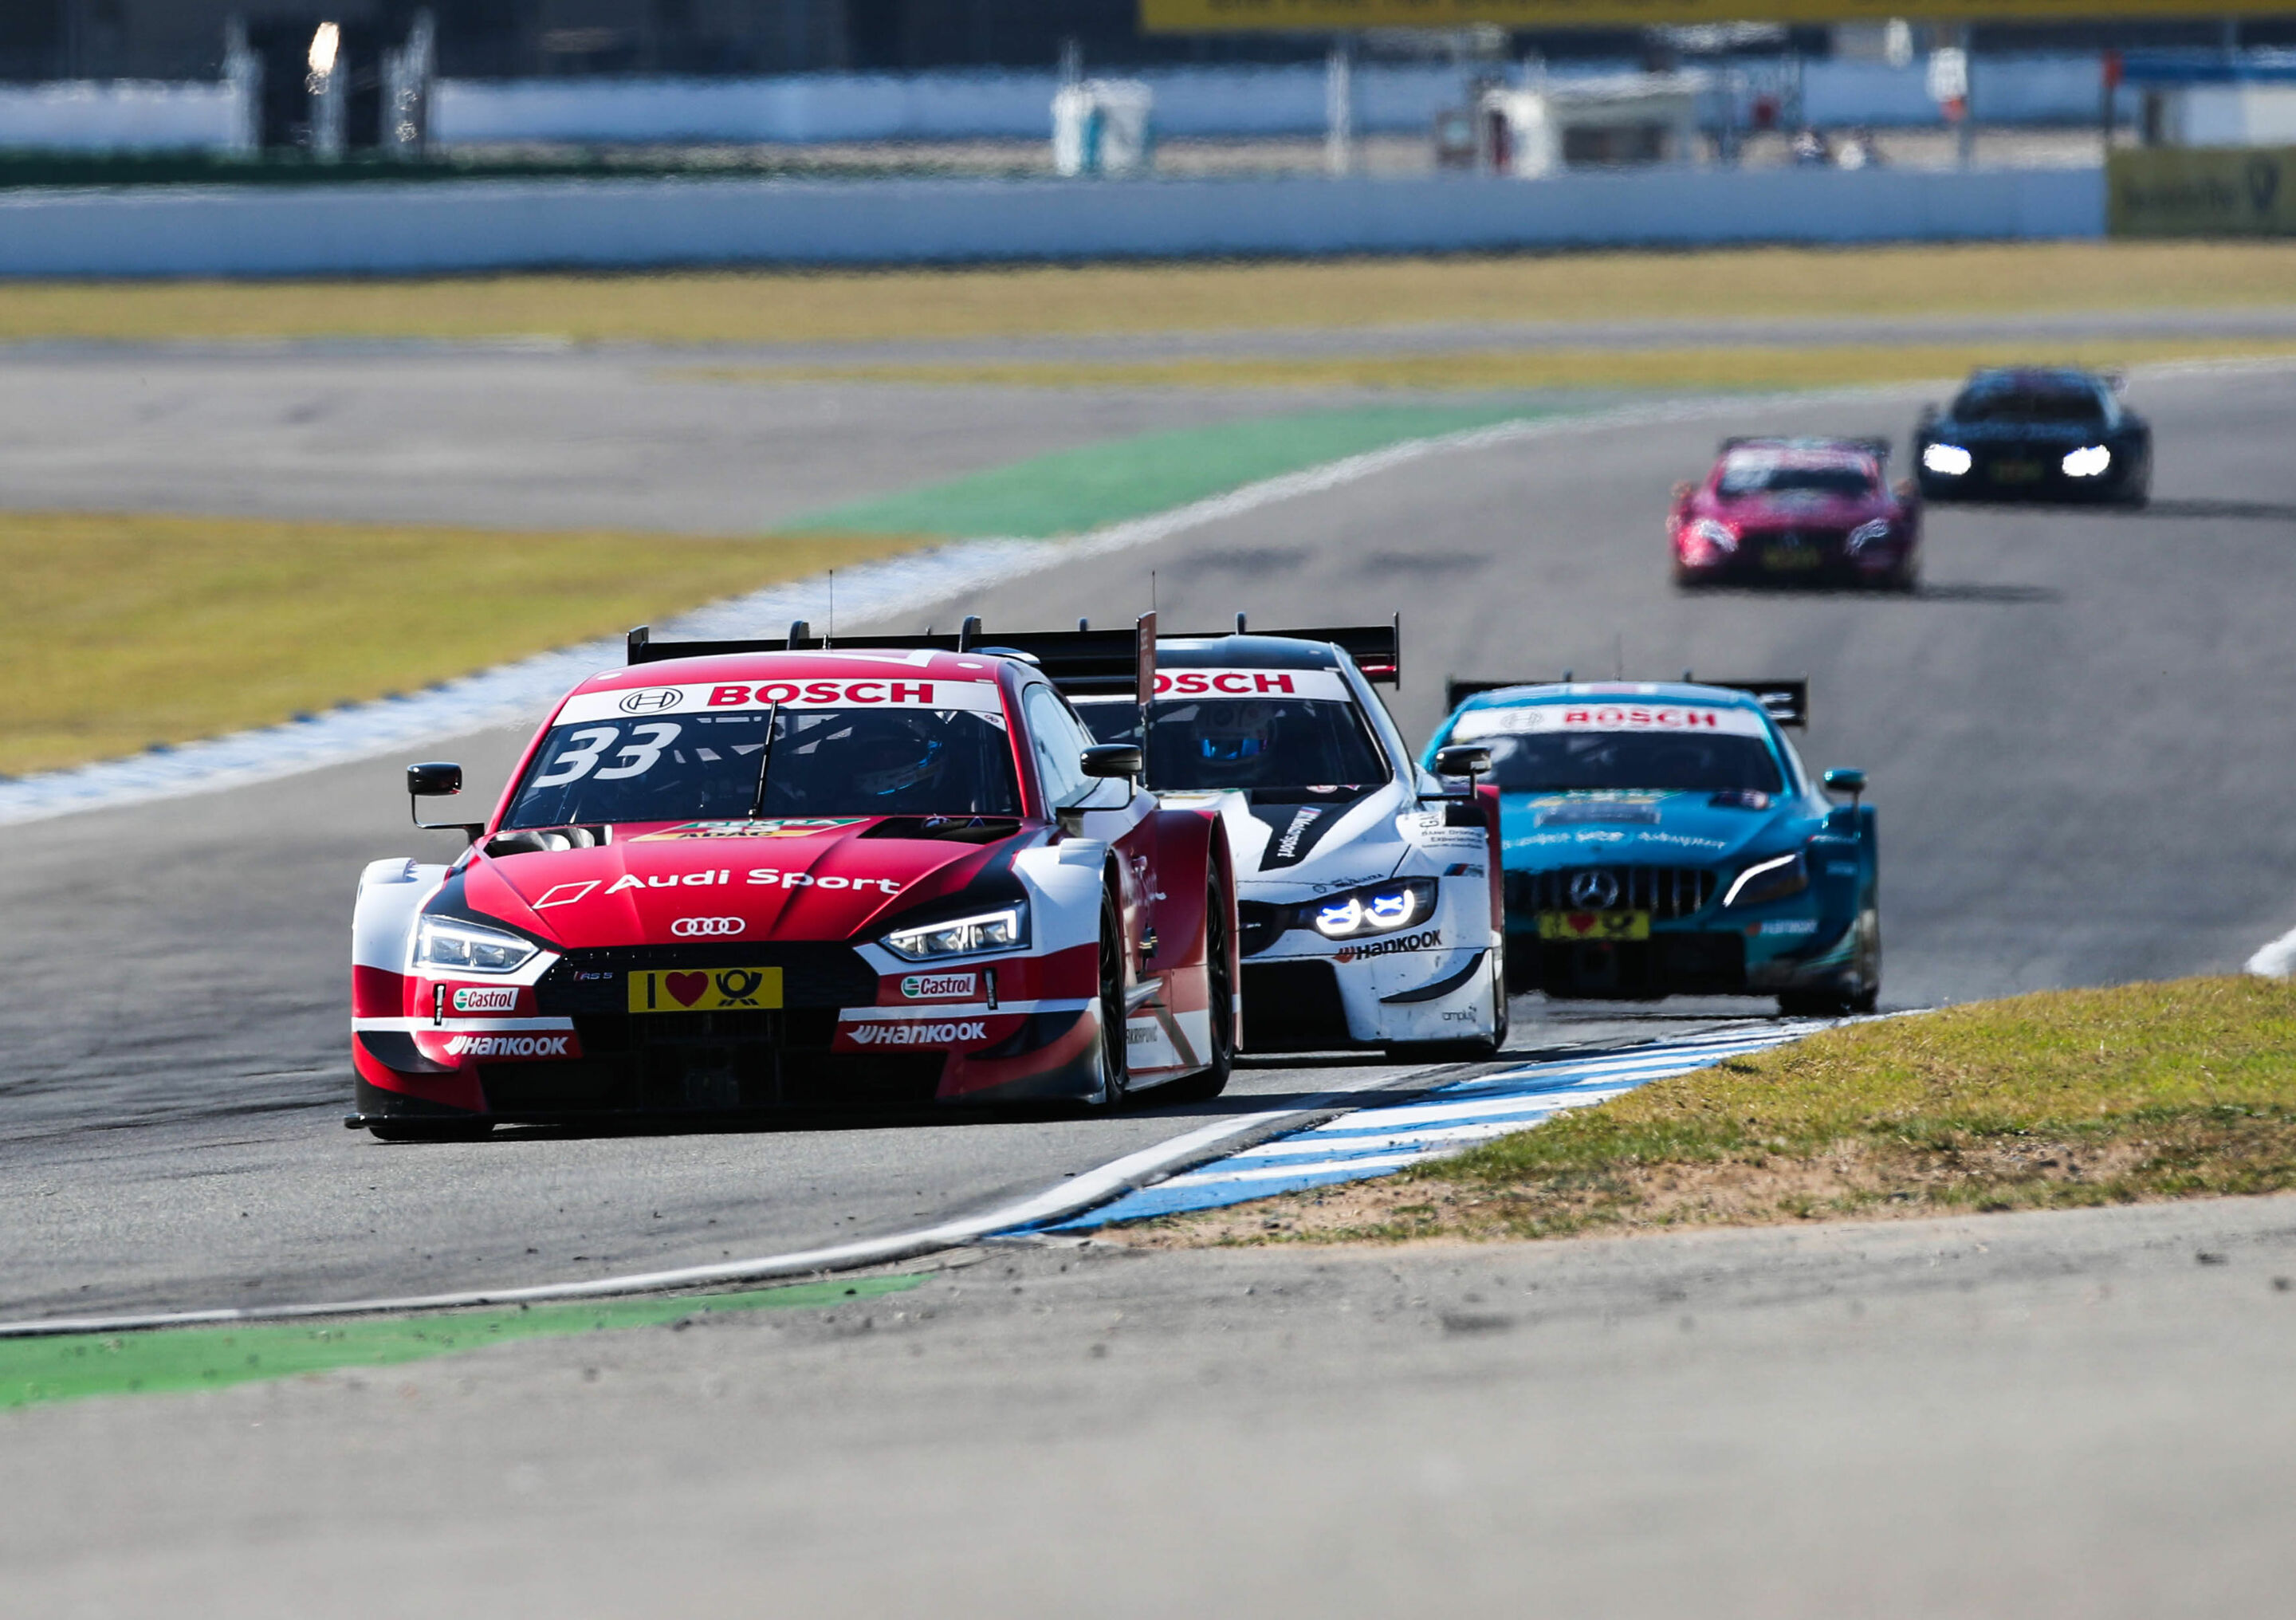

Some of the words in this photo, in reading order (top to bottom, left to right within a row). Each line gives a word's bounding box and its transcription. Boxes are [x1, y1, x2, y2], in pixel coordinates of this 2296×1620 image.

[707, 682, 934, 707] BOSCH
[1563, 708, 1717, 728] BOSCH
[530, 722, 682, 788] 33
[697, 819, 839, 828] DEKRA
[603, 870, 731, 895] Audi
[746, 868, 901, 895] Sport
[580, 971, 600, 981] RS
[603, 971, 613, 980] 5
[920, 976, 973, 995] Castrol
[467, 990, 514, 1008] Castrol
